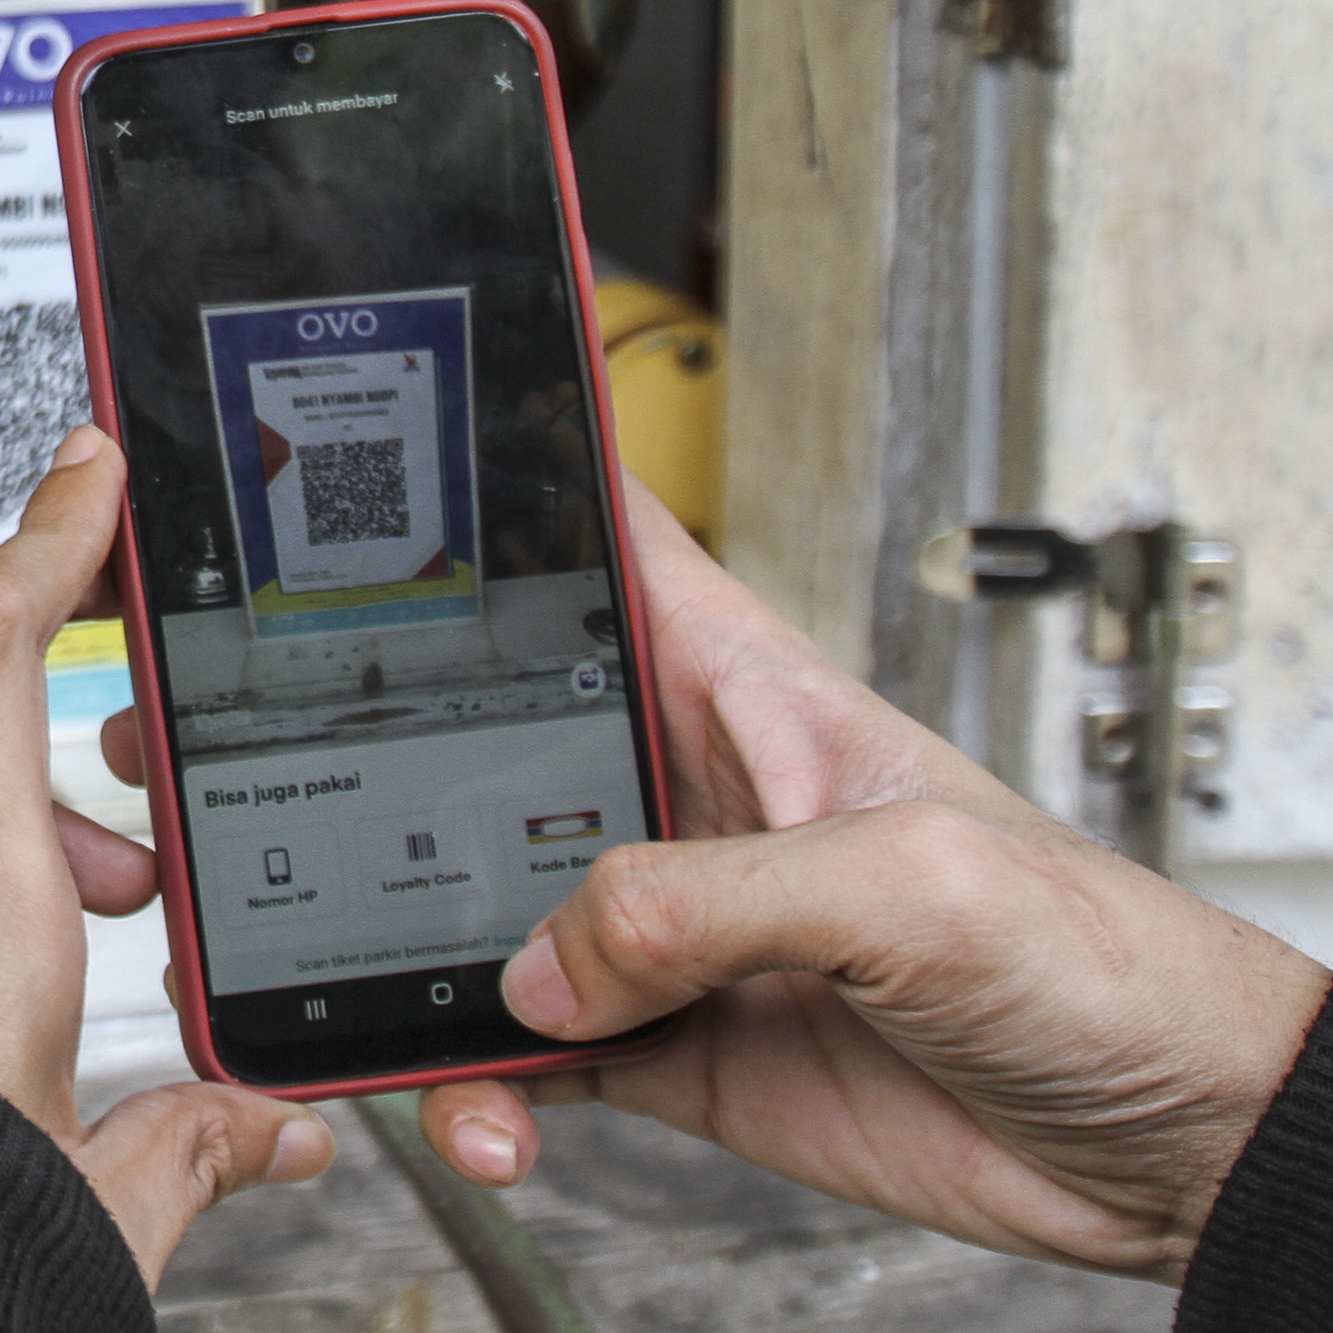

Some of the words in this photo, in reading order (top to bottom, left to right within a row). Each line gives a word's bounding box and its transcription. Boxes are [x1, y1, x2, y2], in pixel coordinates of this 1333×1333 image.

[225, 109, 265, 124] Scan
[269, 100, 313, 119] untuk
[316, 92, 399, 114] membayar
[297, 309, 379, 342] OVO
[204, 788, 249, 808] Bisa
[253, 783, 300, 808] juga
[305, 771, 362, 800] pakai
[530, 856, 567, 874] Kode
[383, 875, 431, 893] Loyalty
[434, 870, 473, 887] Code
[247, 895, 294, 910] Nomor
[297, 889, 318, 905] HP
[296, 956, 329, 973] Scan
[331, 950, 361, 967] tiket
[364, 948, 402, 966] parkir
[404, 935, 489, 960] bermasalah?
